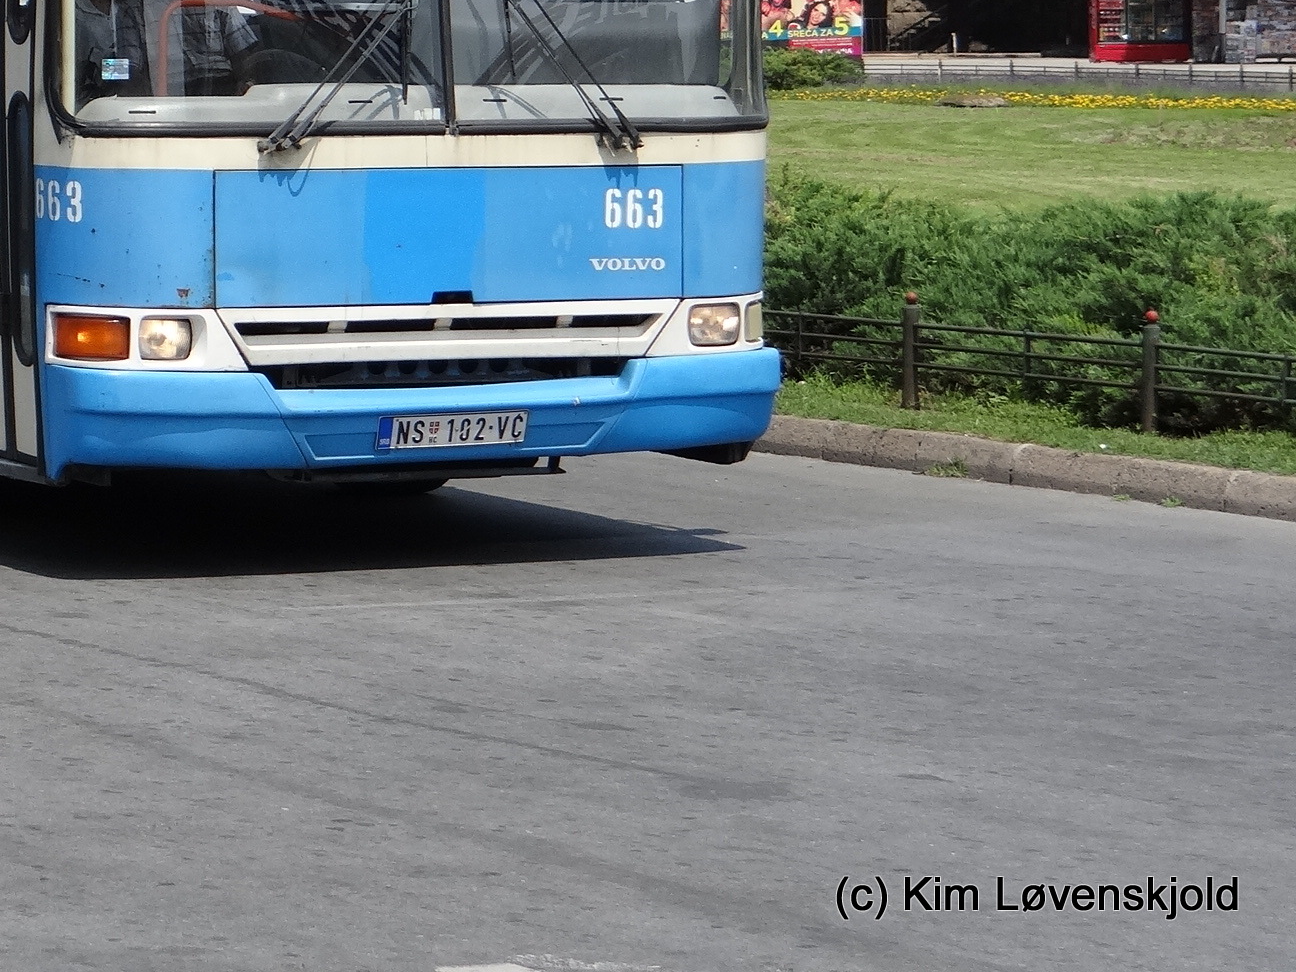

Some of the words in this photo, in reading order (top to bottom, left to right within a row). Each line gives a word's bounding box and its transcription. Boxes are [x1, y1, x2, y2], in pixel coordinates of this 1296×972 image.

[769, 19, 783, 38] 4
[820, 28, 834, 37] ZA
[834, 16, 849, 36] 5
[35, 177, 83, 224] 663
[604, 188, 664, 229] 663
[588, 257, 666, 272] VOLVO
[396, 419, 426, 445] NS
